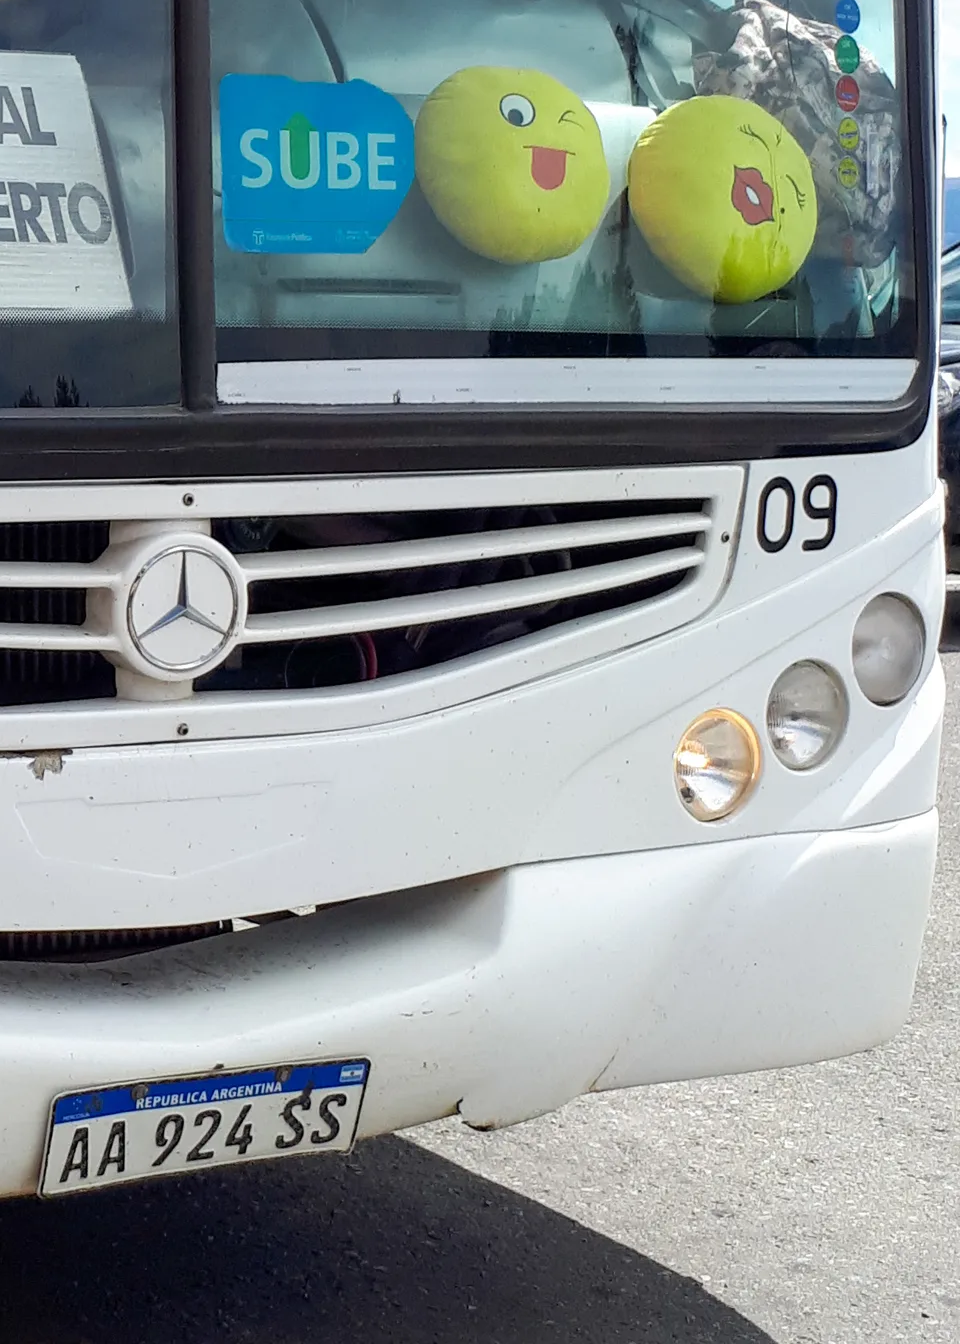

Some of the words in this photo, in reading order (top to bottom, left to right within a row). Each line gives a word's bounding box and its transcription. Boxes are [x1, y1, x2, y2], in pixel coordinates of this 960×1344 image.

[240, 128, 397, 191] SUBE
[756, 474, 838, 554] 09
[136, 1089, 208, 1110] REPUBLICA
[211, 1080, 283, 1102] ARGENTINA
[59, 1120, 126, 1183] AA
[151, 1104, 253, 1168] 924
[275, 1092, 347, 1150] SS
